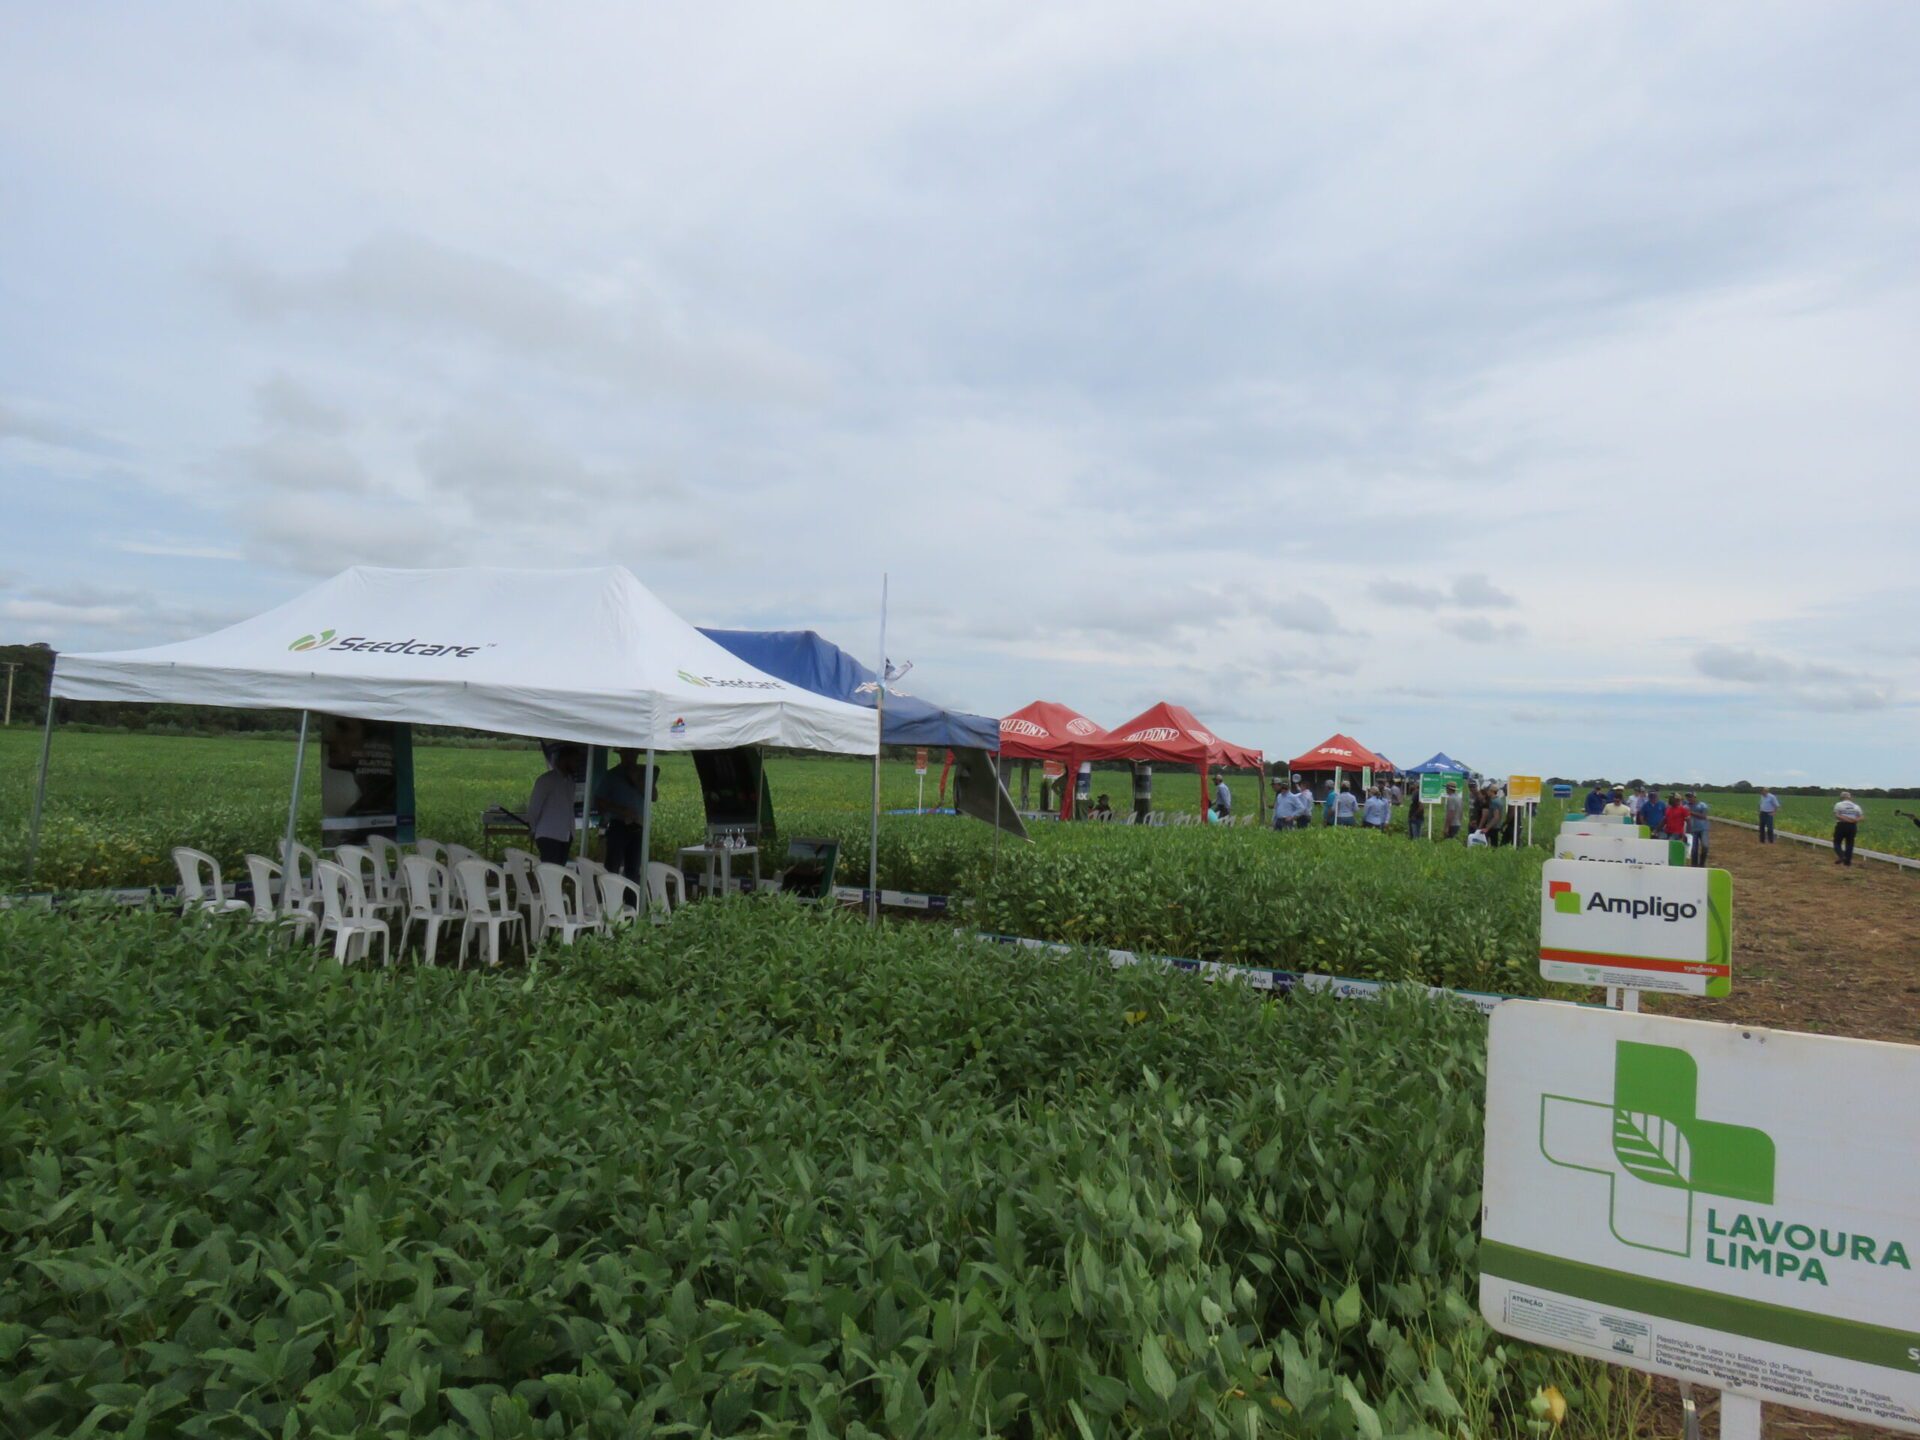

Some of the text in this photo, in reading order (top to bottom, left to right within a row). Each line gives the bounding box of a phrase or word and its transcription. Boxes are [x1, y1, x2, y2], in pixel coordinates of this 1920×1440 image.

[328, 636, 481, 658] Seedcare
[703, 676, 786, 690] Seedcare
[1587, 891, 1697, 922] Ampligo
[1351, 987, 1374, 996] Elatu
[1707, 1207, 1912, 1270] LAVOURA
[1705, 1238, 1830, 1287] LIMPA
[1511, 1294, 1544, 1308] ATENÇÃO
[1656, 1334, 1694, 1349] Restrição
[1695, 1343, 1706, 1352] de
[1708, 1347, 1723, 1356] uso
[1725, 1351, 1736, 1359] no
[1738, 1353, 1767, 1366] Estado
[1769, 1360, 1780, 1369] do
[1656, 1342, 1699, 1358] Informe-se
[1701, 1352, 1724, 1363] sobre
[1733, 1360, 1760, 1372] realize
[1770, 1369, 1801, 1383] Manejo
[1803, 1377, 1845, 1392] Integrado
[1655, 1357, 1673, 1367] Uso
[1675, 1361, 1711, 1376] agrícola.
[1742, 1377, 1758, 1387] sob
[1813, 1393, 1855, 1409] Consulte
[1857, 1404, 1872, 1413] um
[1656, 1349, 1691, 1364] Descarte
[1693, 1358, 1748, 1377] corretamente
[1749, 1371, 1759, 1380] as
[1761, 1375, 1813, 1393] embalagens
[1822, 1389, 1849, 1401] restos
[1851, 1394, 1863, 1404] de
